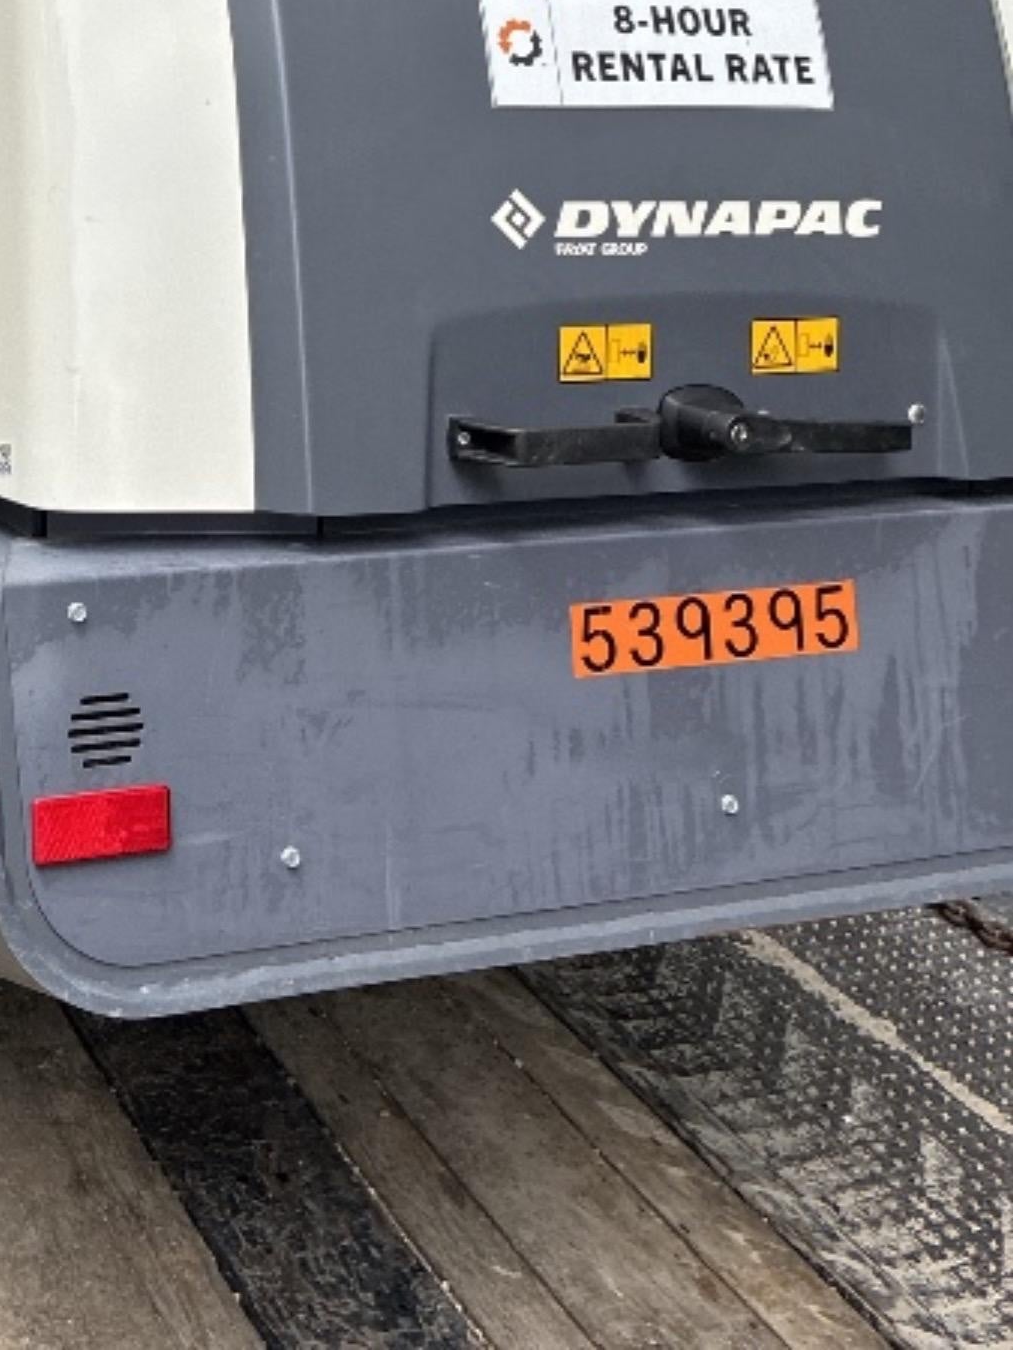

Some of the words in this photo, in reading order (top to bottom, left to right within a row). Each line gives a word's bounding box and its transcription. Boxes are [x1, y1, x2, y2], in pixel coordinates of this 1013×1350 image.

[613, 5, 753, 37] 8-HOUR
[571, 52, 714, 82] RENTAL
[726, 54, 816, 84] RATE
[554, 200, 882, 238] DYNAPAC
[581, 584, 850, 673] 539395
